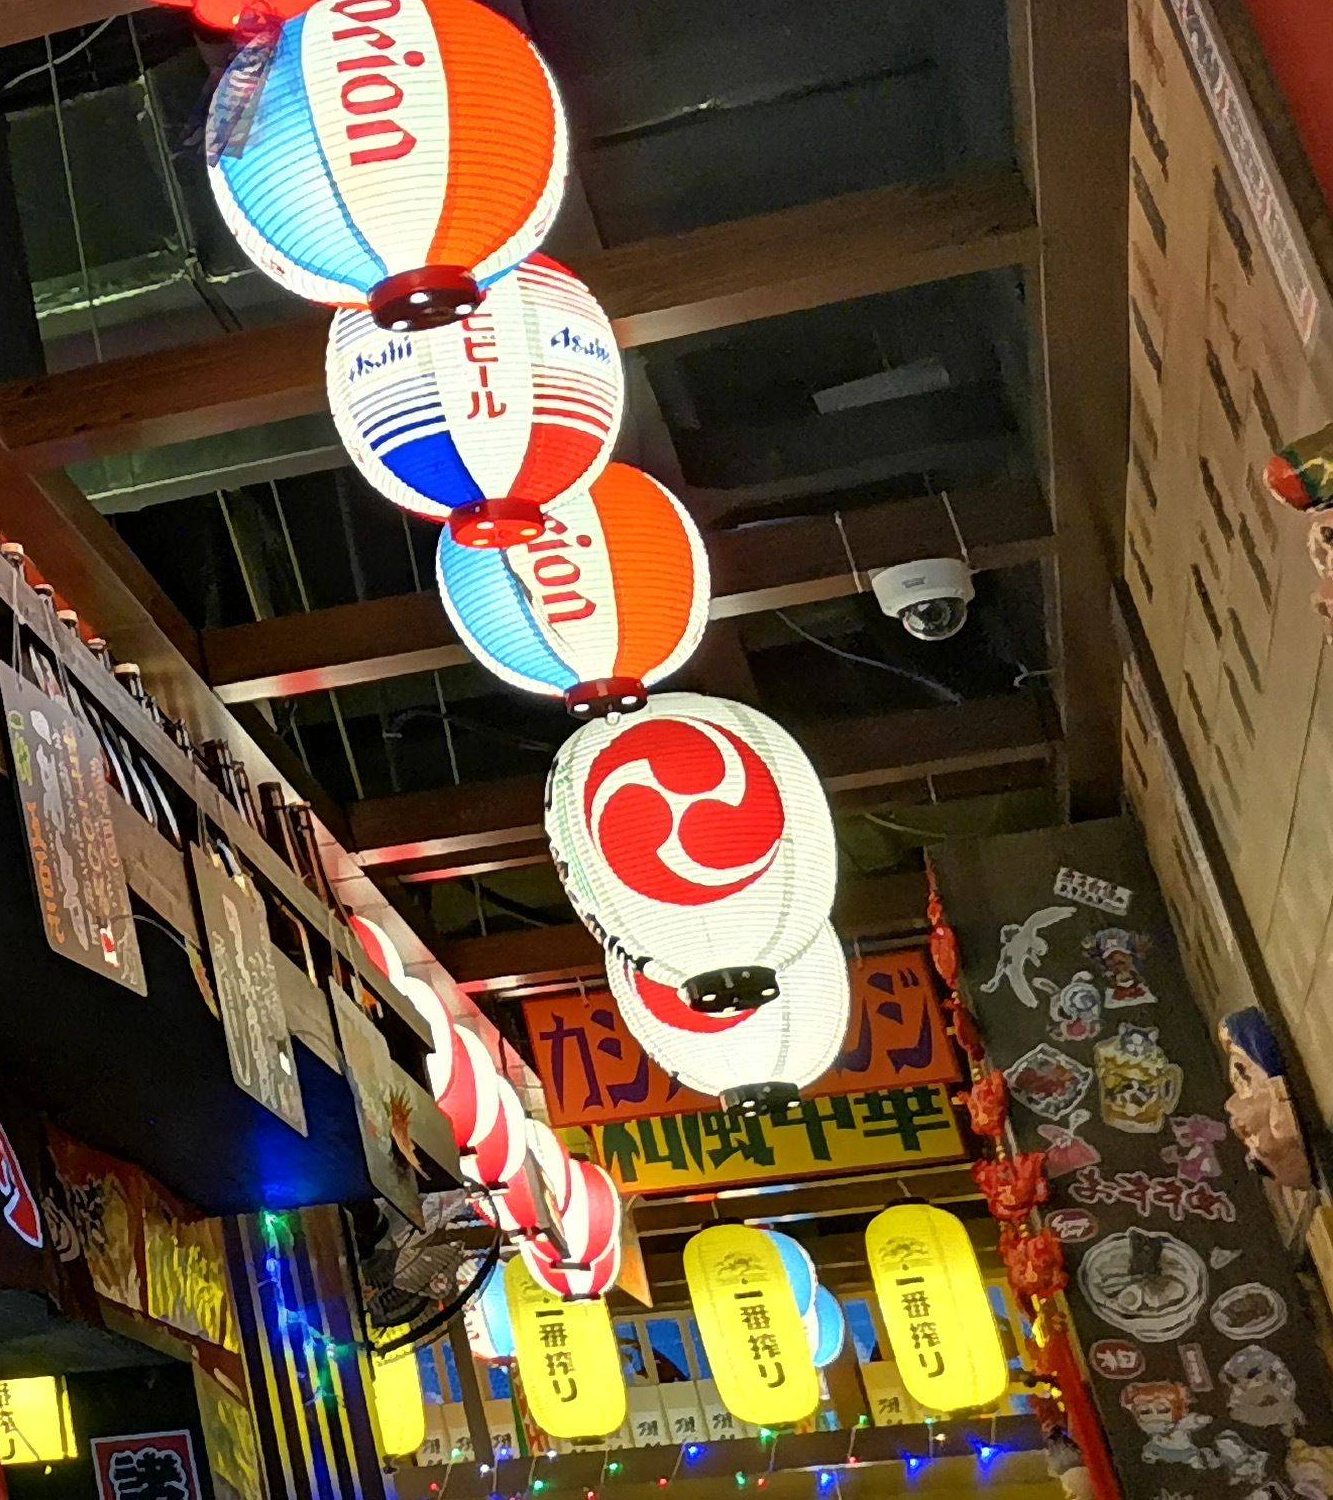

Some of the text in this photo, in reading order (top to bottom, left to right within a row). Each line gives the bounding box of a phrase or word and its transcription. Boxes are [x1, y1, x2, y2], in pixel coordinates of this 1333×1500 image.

[524, 513, 599, 624] rion
[534, 1307, 578, 1404] 一番搾り
[733, 1288, 786, 1390] 一番搾り
[896, 1272, 945, 1379] 一番搾り
